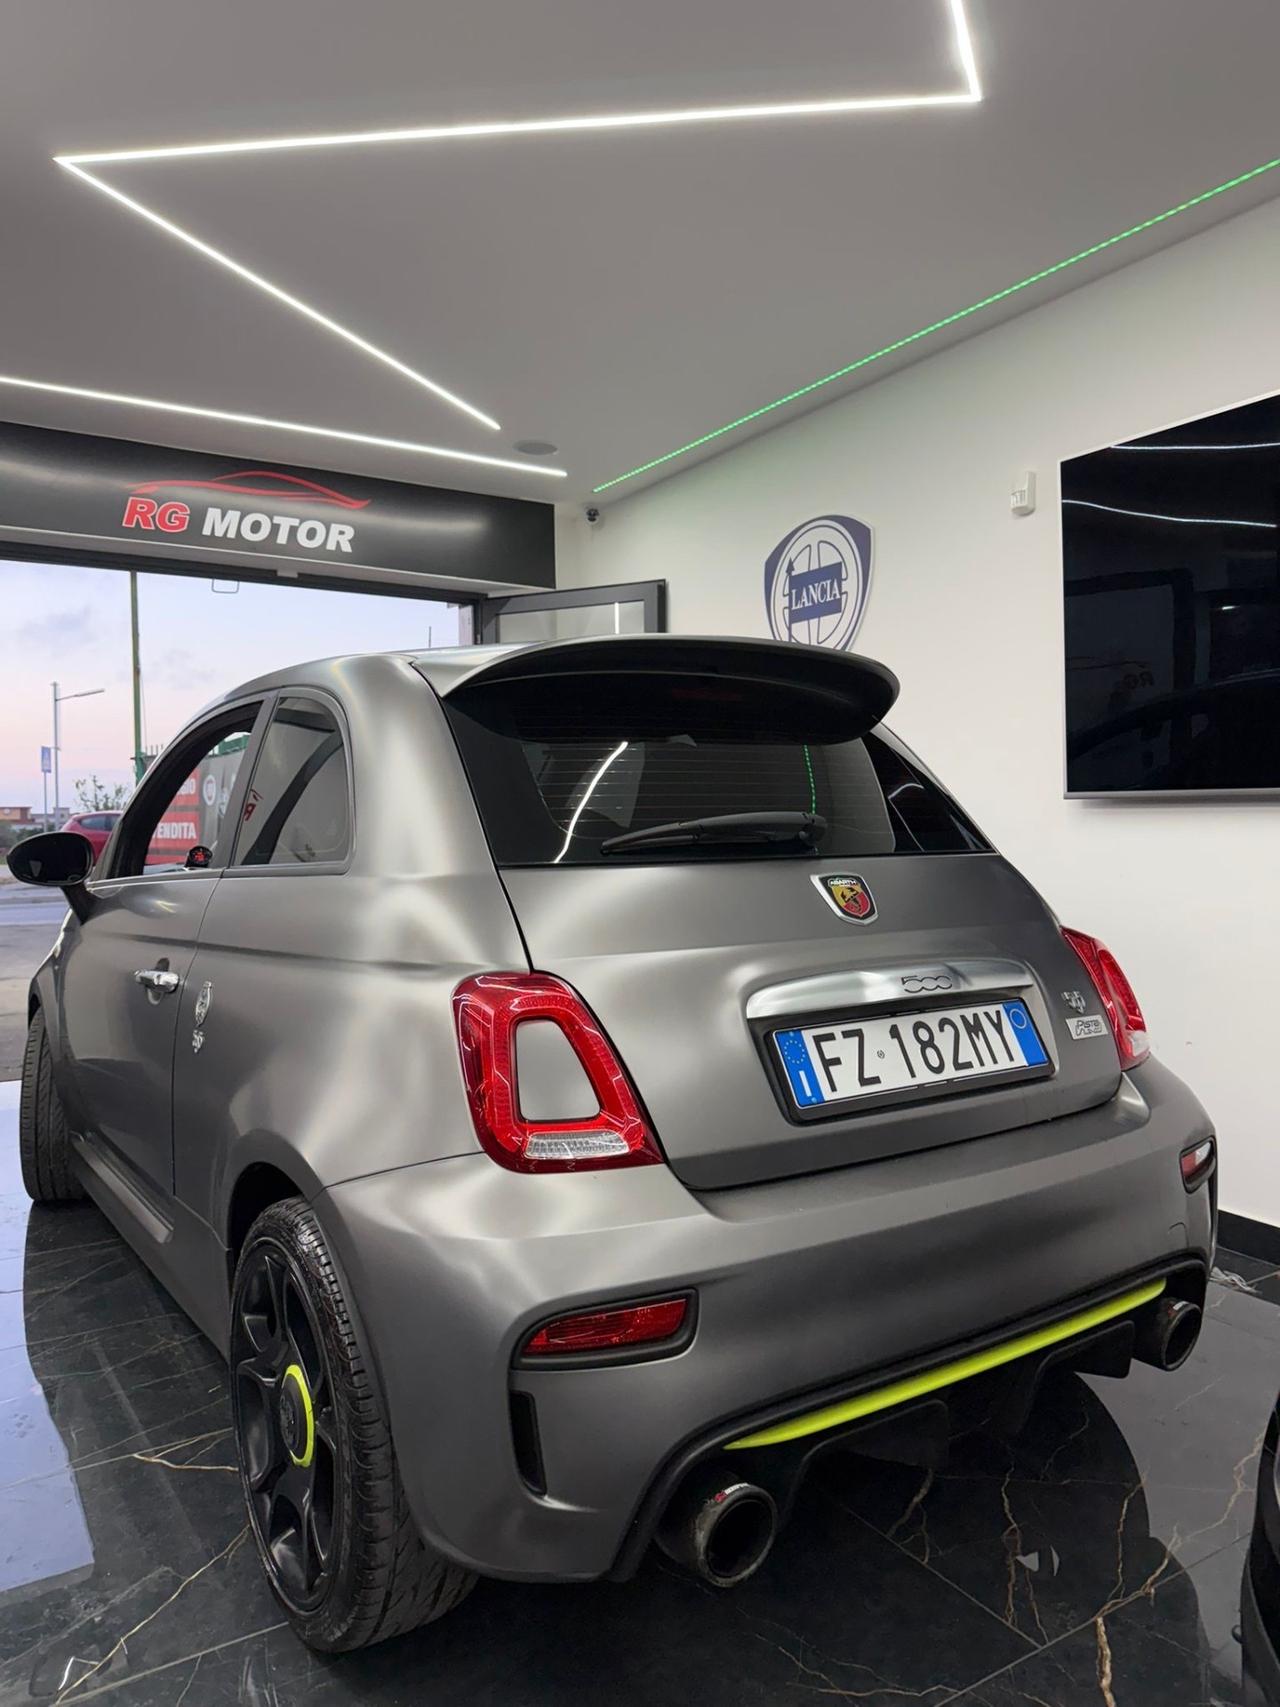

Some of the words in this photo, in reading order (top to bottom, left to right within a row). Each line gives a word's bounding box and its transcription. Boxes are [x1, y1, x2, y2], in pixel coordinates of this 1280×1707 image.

[122, 497, 190, 533] RG
[202, 507, 355, 553] MOTOR
[791, 578, 841, 610] LANCIA
[812, 1028, 882, 1093] FZ
[889, 1010, 1015, 1076] 182MY
